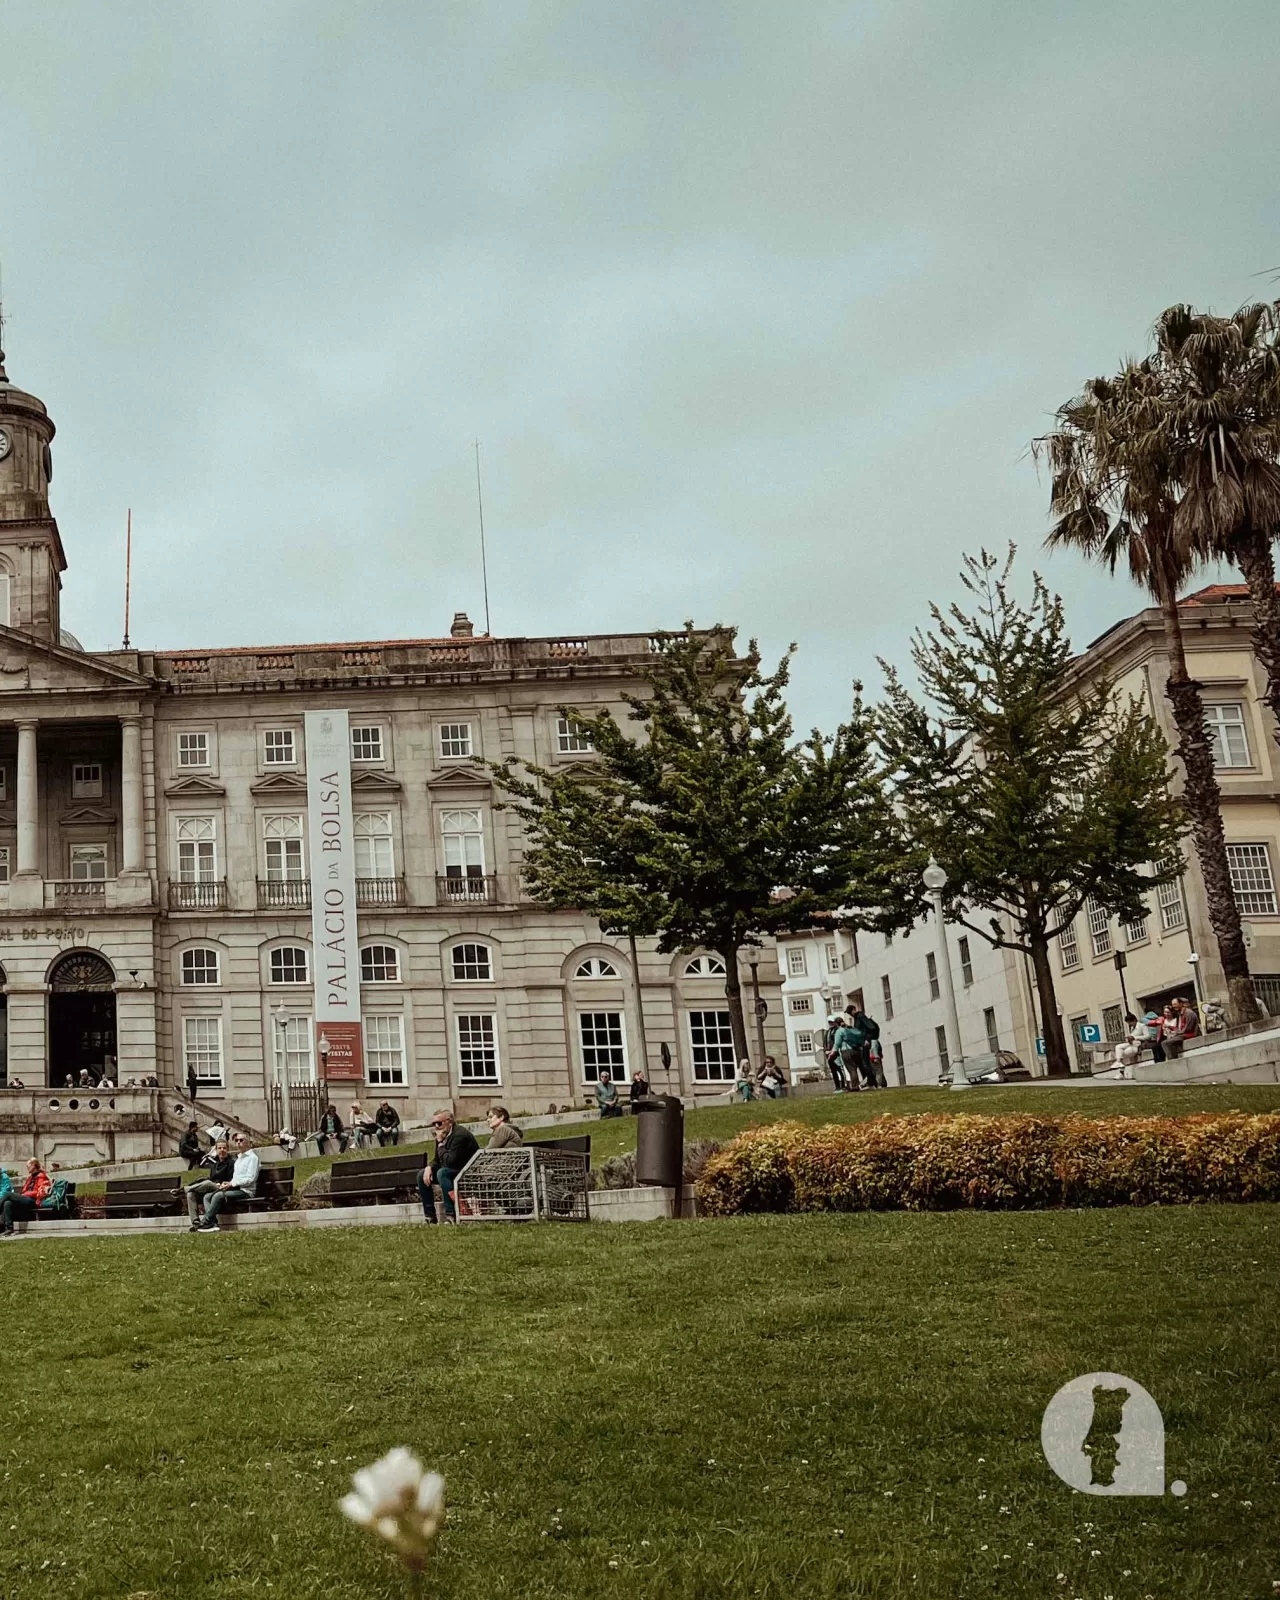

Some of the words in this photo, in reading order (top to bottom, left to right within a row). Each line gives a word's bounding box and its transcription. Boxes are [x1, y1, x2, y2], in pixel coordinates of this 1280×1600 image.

[320, 772, 342, 852] BOLSA
[328, 862, 339, 879] DA
[22, 928, 38, 940] DO
[45, 926, 85, 940] PORTO
[321, 889, 348, 1006] PALÁCIO
[1083, 1026, 1096, 1041] P
